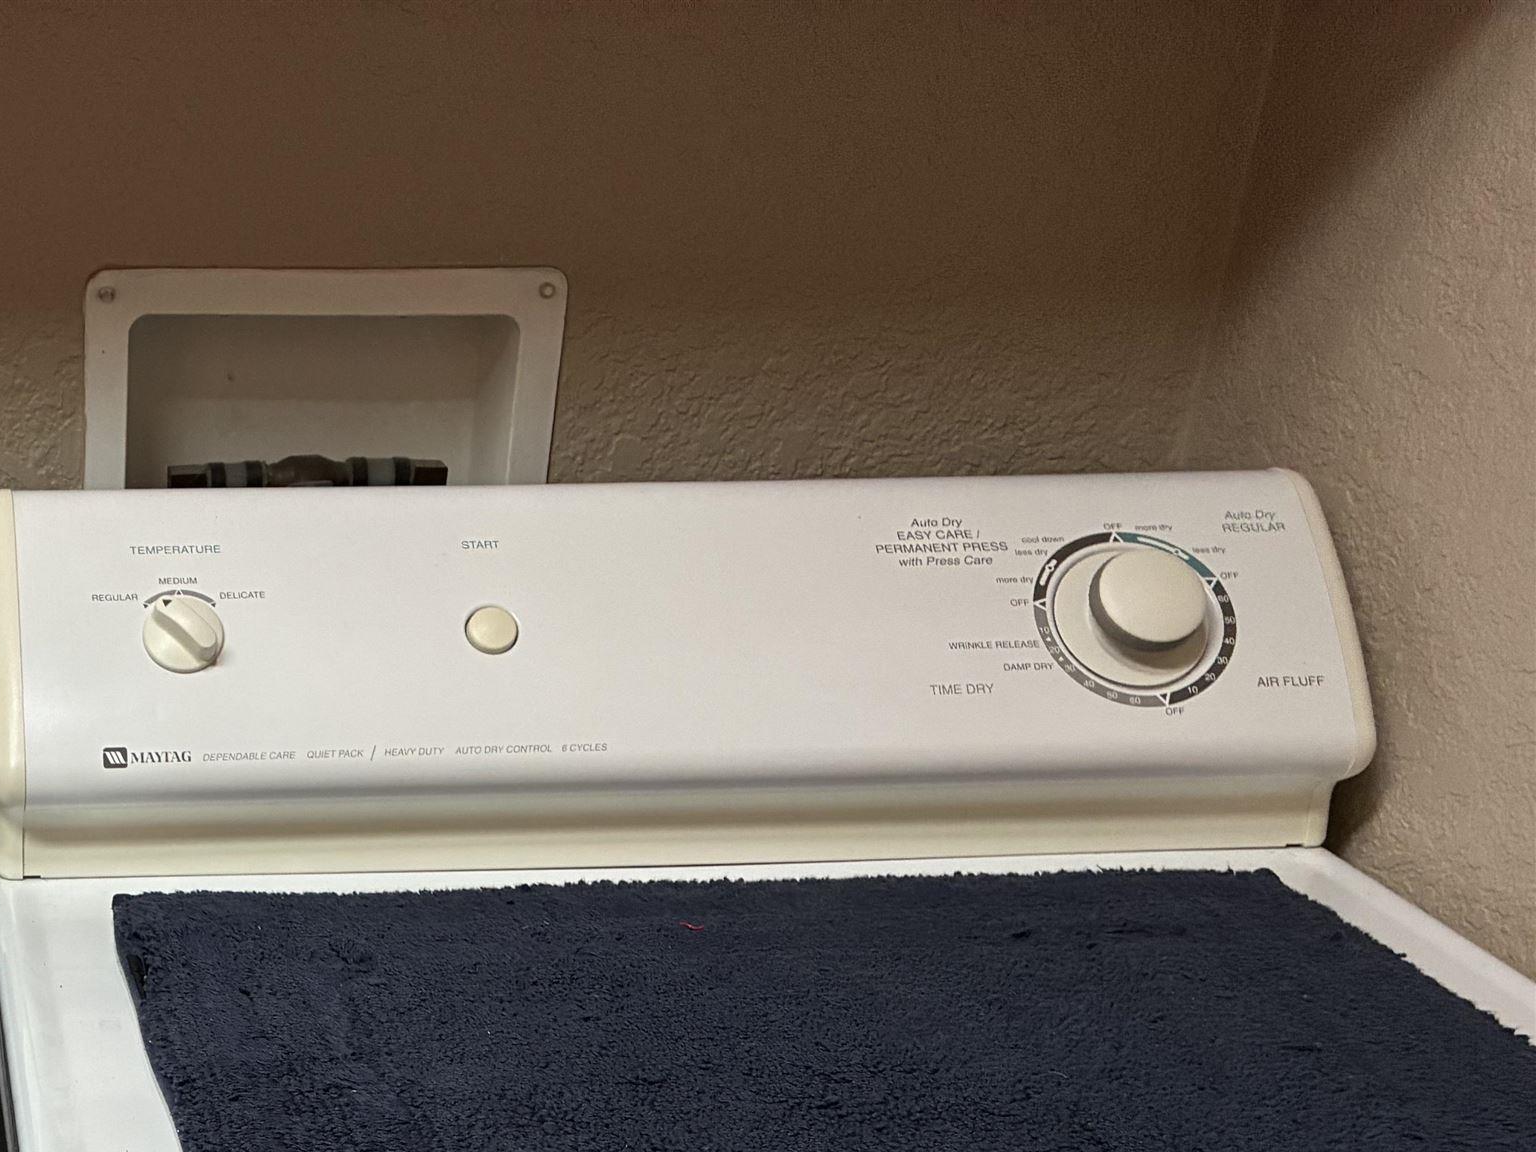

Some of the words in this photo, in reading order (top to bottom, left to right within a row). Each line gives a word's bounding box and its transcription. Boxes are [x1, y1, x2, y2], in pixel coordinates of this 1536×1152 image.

[1225, 511, 1251, 520] Auto
[1255, 510, 1275, 520] Dry
[911, 518, 938, 527] Auto
[942, 517, 962, 528] Dry
[1222, 522, 1286, 533] REGULAR
[897, 530, 933, 540] EASY
[936, 530, 973, 539] CARE
[130, 545, 221, 555] TEMPERATURE
[461, 540, 499, 550] START
[876, 543, 959, 554] PERMANENT
[963, 542, 1008, 551] PRESS
[1211, 546, 1225, 554] dry
[899, 556, 922, 567] with
[927, 556, 961, 566] Press
[964, 556, 993, 565] Care
[158, 577, 197, 585] MEDIUM
[1020, 576, 1034, 584] dry
[92, 593, 138, 602] REGULAR
[219, 590, 265, 599] DELICATE
[1010, 599, 1029, 607] OFF
[948, 642, 993, 650] WRINKLE
[996, 640, 1040, 648] RELEASE
[1224, 637, 1235, 645] 40
[1216, 657, 1228, 665] 30
[1034, 663, 1053, 671] DRY
[1205, 673, 1215, 681] 20
[1257, 676, 1280, 687] AIR
[1283, 676, 1325, 686] FLUFF
[930, 684, 962, 695] TIME
[966, 683, 994, 694] DRY
[1188, 686, 1198, 694] 10
[1165, 707, 1184, 716] OFF
[131, 751, 192, 764] MAYTAG
[203, 752, 266, 762] DEPENDABLE
[269, 751, 296, 760] CARE
[307, 750, 336, 759] QUIET
[338, 750, 363, 758] PACK
[385, 748, 416, 757] HEAVY
[418, 747, 445, 756] DUTY
[455, 746, 482, 755] AUTO
[484, 746, 503, 754] DRY
[506, 745, 552, 753] CONTROL
[570, 743, 607, 752] CYCLES
